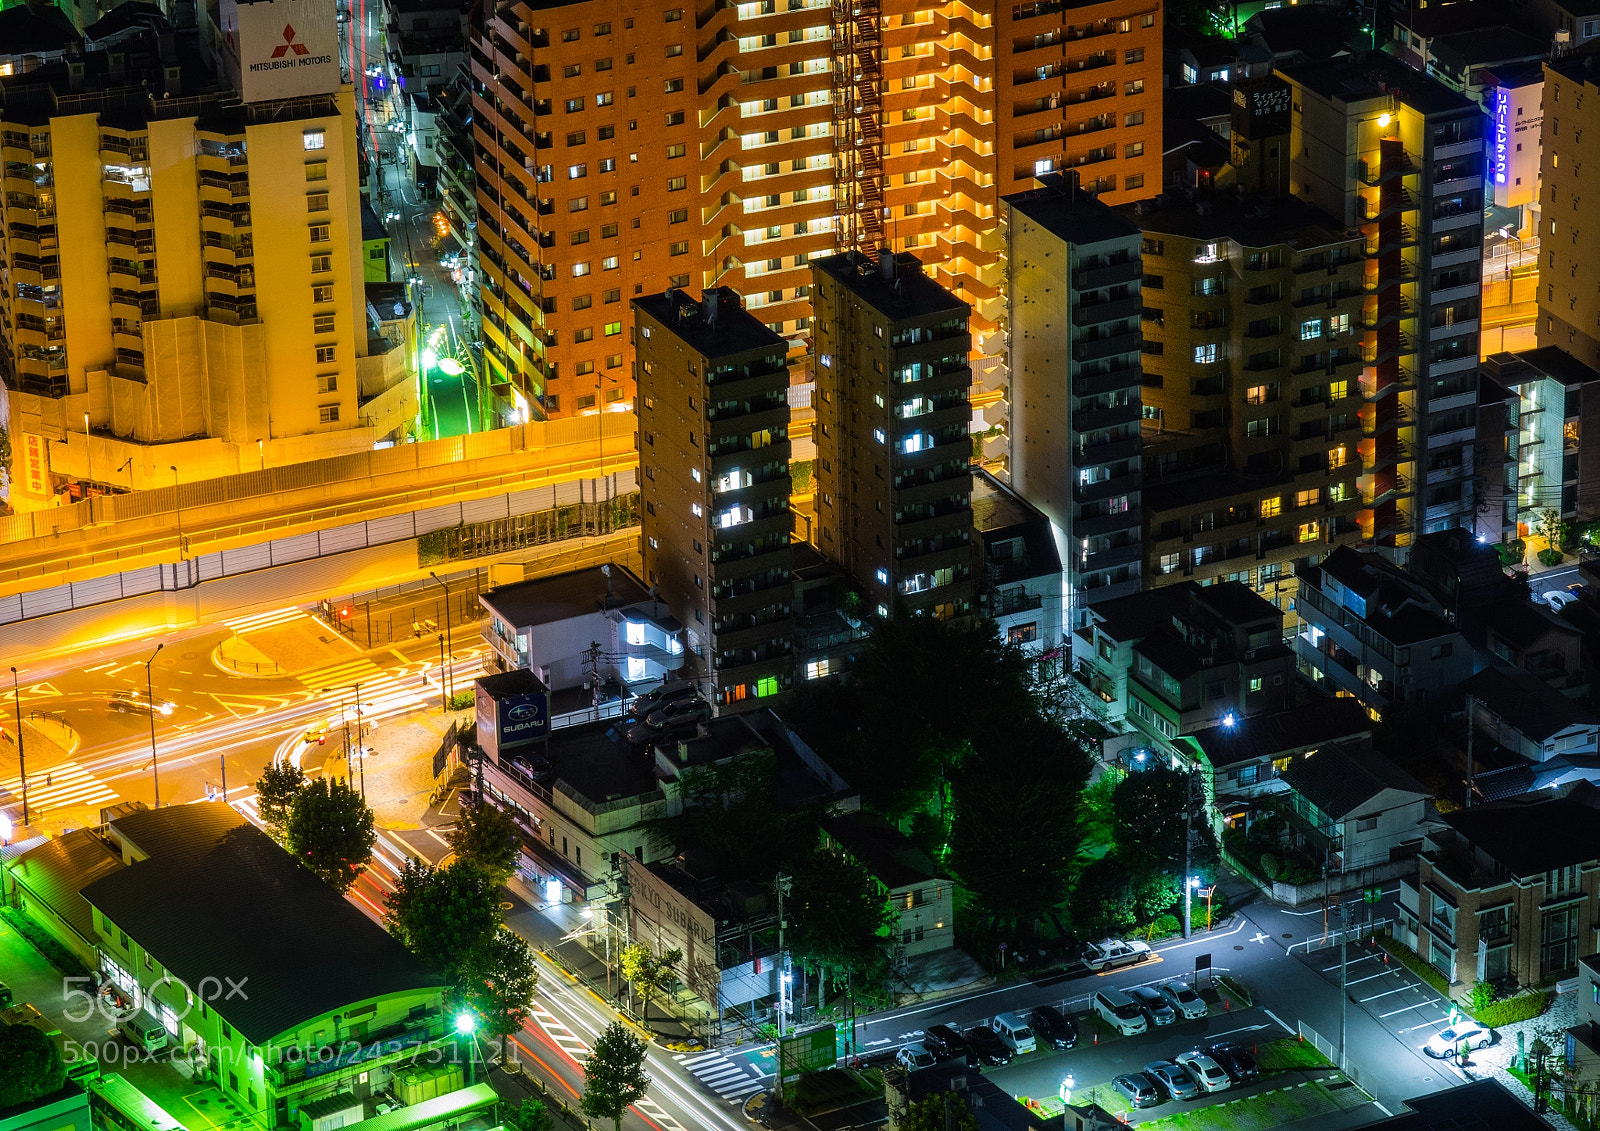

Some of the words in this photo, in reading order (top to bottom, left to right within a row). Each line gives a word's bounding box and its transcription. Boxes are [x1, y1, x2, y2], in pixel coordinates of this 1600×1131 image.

[249, 59, 296, 72] MITSUBISHI
[299, 55, 332, 67] MOTORS
[28, 435, 42, 492] 店舗営業中
[503, 720, 544, 733] SUBARU
[666, 901, 708, 945] SUBARU
